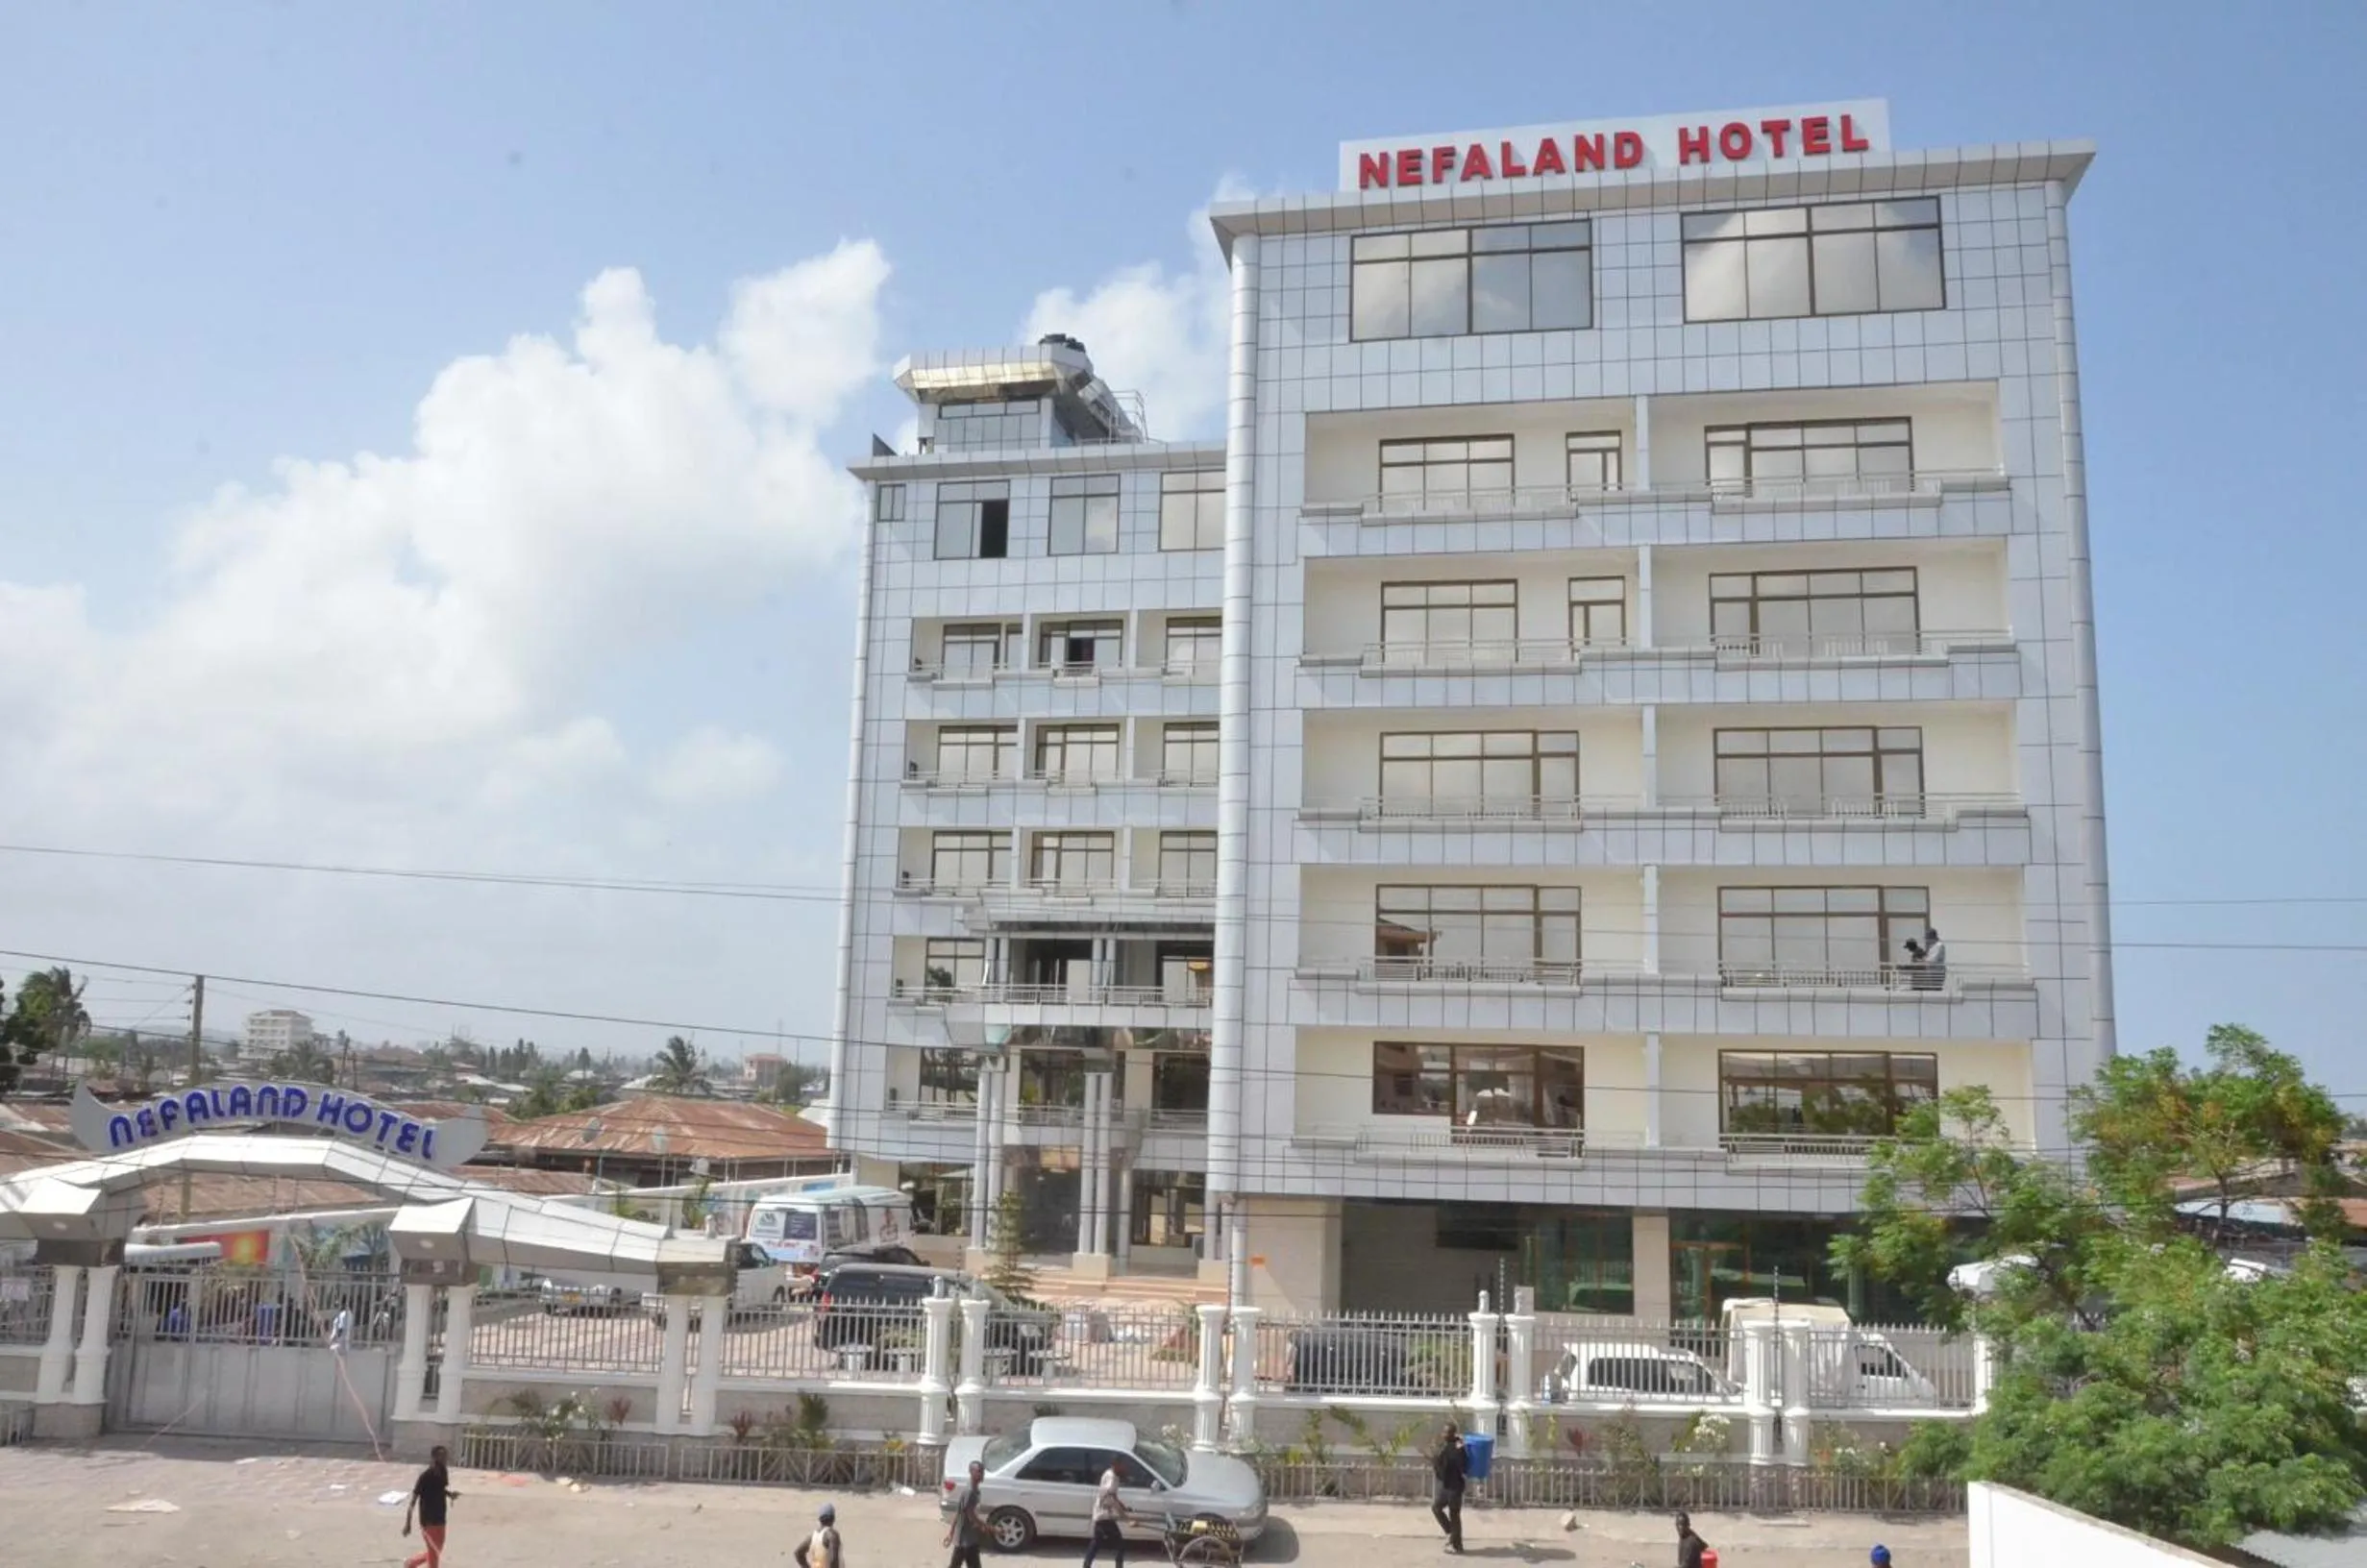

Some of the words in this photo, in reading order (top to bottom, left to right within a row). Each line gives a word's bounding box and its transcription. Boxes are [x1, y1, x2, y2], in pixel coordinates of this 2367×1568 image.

[1359, 131, 1642, 188] NEFALAND
[1678, 114, 1868, 164] HOTEL
[110, 1086, 308, 1147] NEFALAND
[316, 1092, 437, 1159] HOTEL
